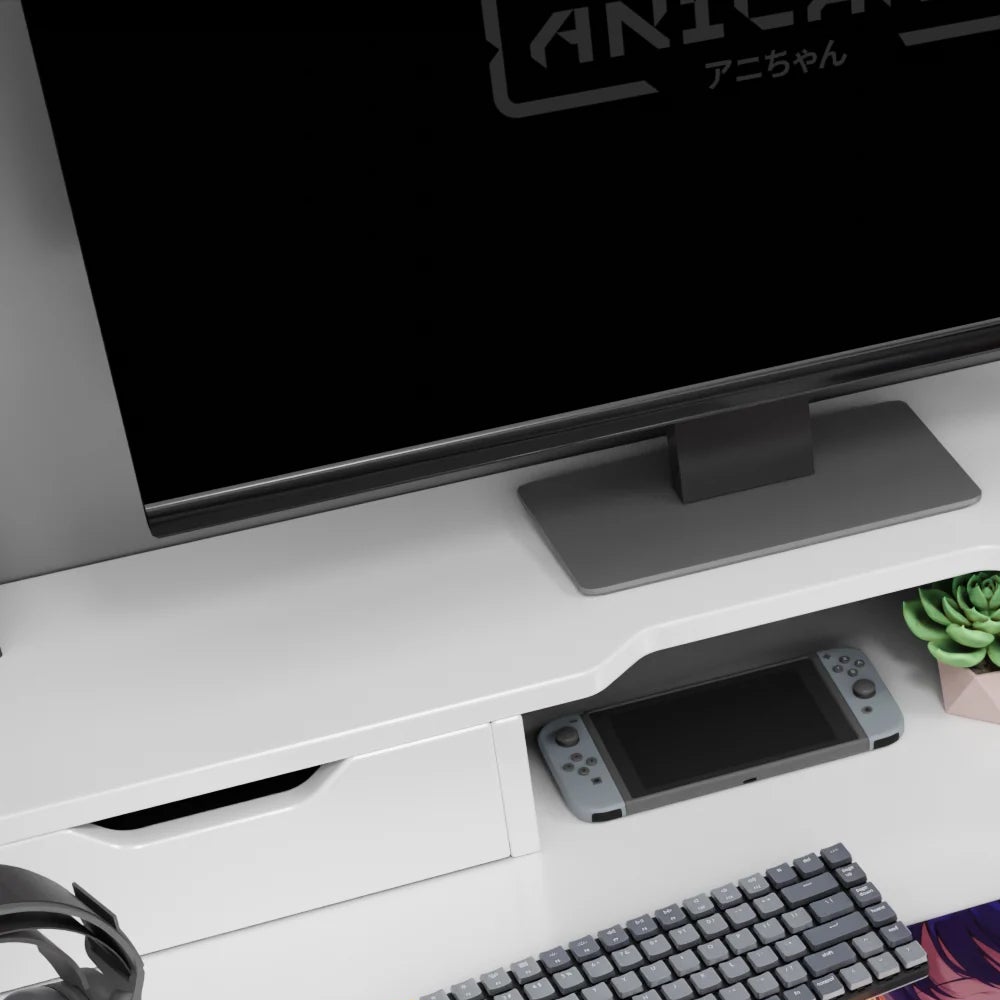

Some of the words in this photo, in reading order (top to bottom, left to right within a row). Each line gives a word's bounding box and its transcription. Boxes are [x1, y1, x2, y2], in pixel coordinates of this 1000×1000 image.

[704, 39, 848, 90] アニちゃん
[870, 905, 886, 913] home
[821, 950, 834, 958] shift
